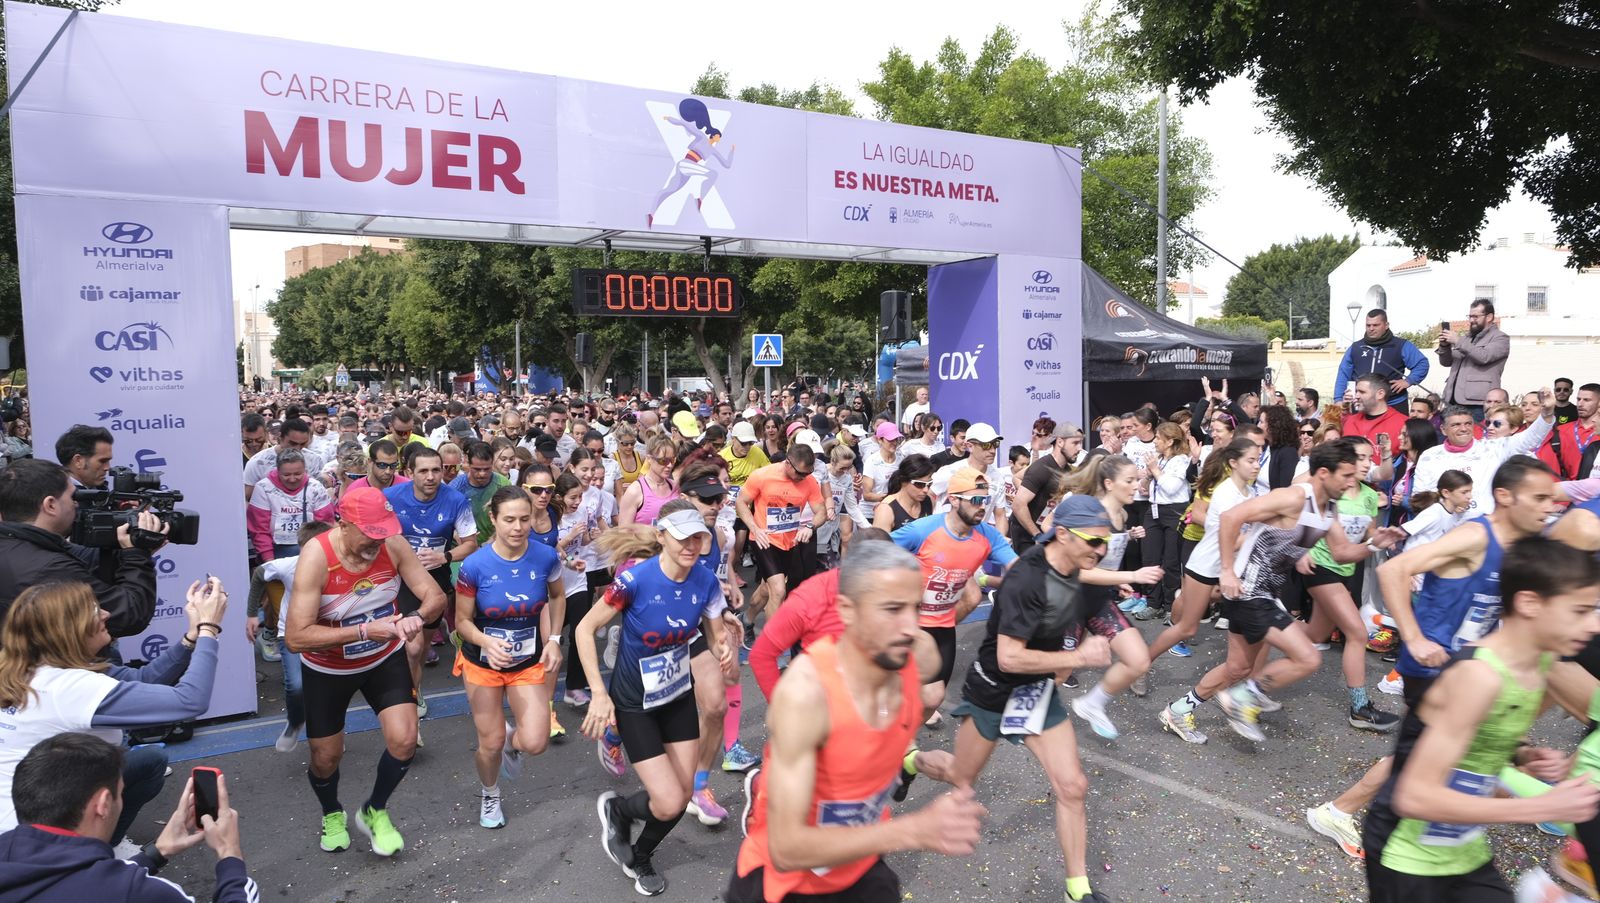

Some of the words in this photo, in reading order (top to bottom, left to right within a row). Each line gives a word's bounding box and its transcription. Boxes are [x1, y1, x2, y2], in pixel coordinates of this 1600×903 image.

[260, 70, 415, 112] CARRERA
[425, 89, 463, 118] DE
[475, 95, 509, 123] LA
[244, 109, 526, 195] MUJER
[863, 142, 884, 162] LA
[889, 144, 974, 172] IGUALDAD
[834, 169, 858, 190] ES
[862, 172, 945, 199] NUESTRA
[948, 182, 999, 203] META.
[843, 203, 872, 222] CDX
[83, 246, 173, 259] HYUNDAI
[95, 259, 164, 272] Almerialva
[109, 287, 181, 303] cajamar
[605, 273, 733, 312] 00:00:00
[1024, 285, 1060, 293] HYUNDAI
[1033, 309, 1062, 320] cajamar
[94, 330, 158, 351] CASI
[1027, 337, 1052, 351] CASI
[938, 346, 983, 380] CDX
[1035, 361, 1061, 370] vithas
[119, 367, 184, 382] vithas
[155, 383, 184, 391] cuidarte
[1030, 390, 1061, 402] aqualia
[110, 414, 185, 434] aqualia
[775, 513, 793, 522] 104
